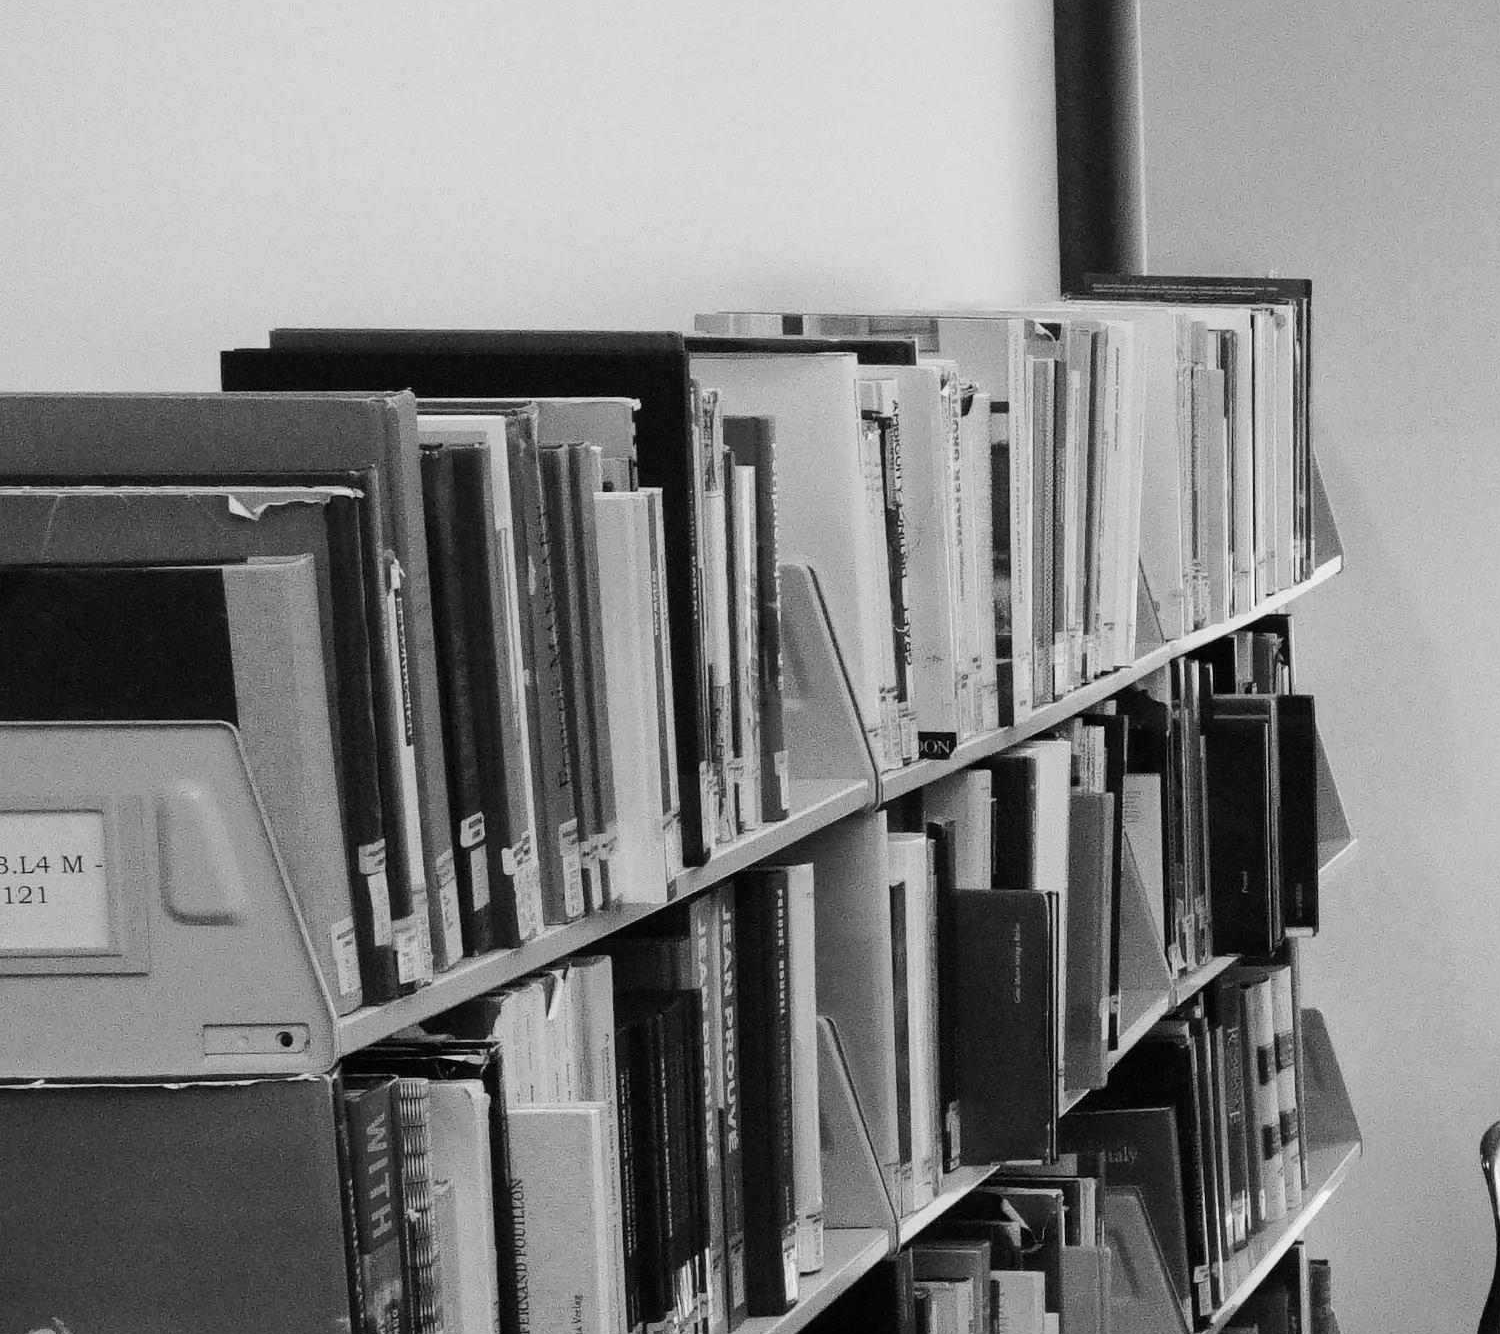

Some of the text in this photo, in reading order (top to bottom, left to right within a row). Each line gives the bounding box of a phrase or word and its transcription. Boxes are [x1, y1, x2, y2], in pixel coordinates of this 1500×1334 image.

[61, 855, 84, 873] M
[722, 905, 733, 997] JEAN
[365, 1111, 392, 1239] WITH
[1101, 1145, 1139, 1165] taly
[509, 1178, 529, 1258] POUILLON
